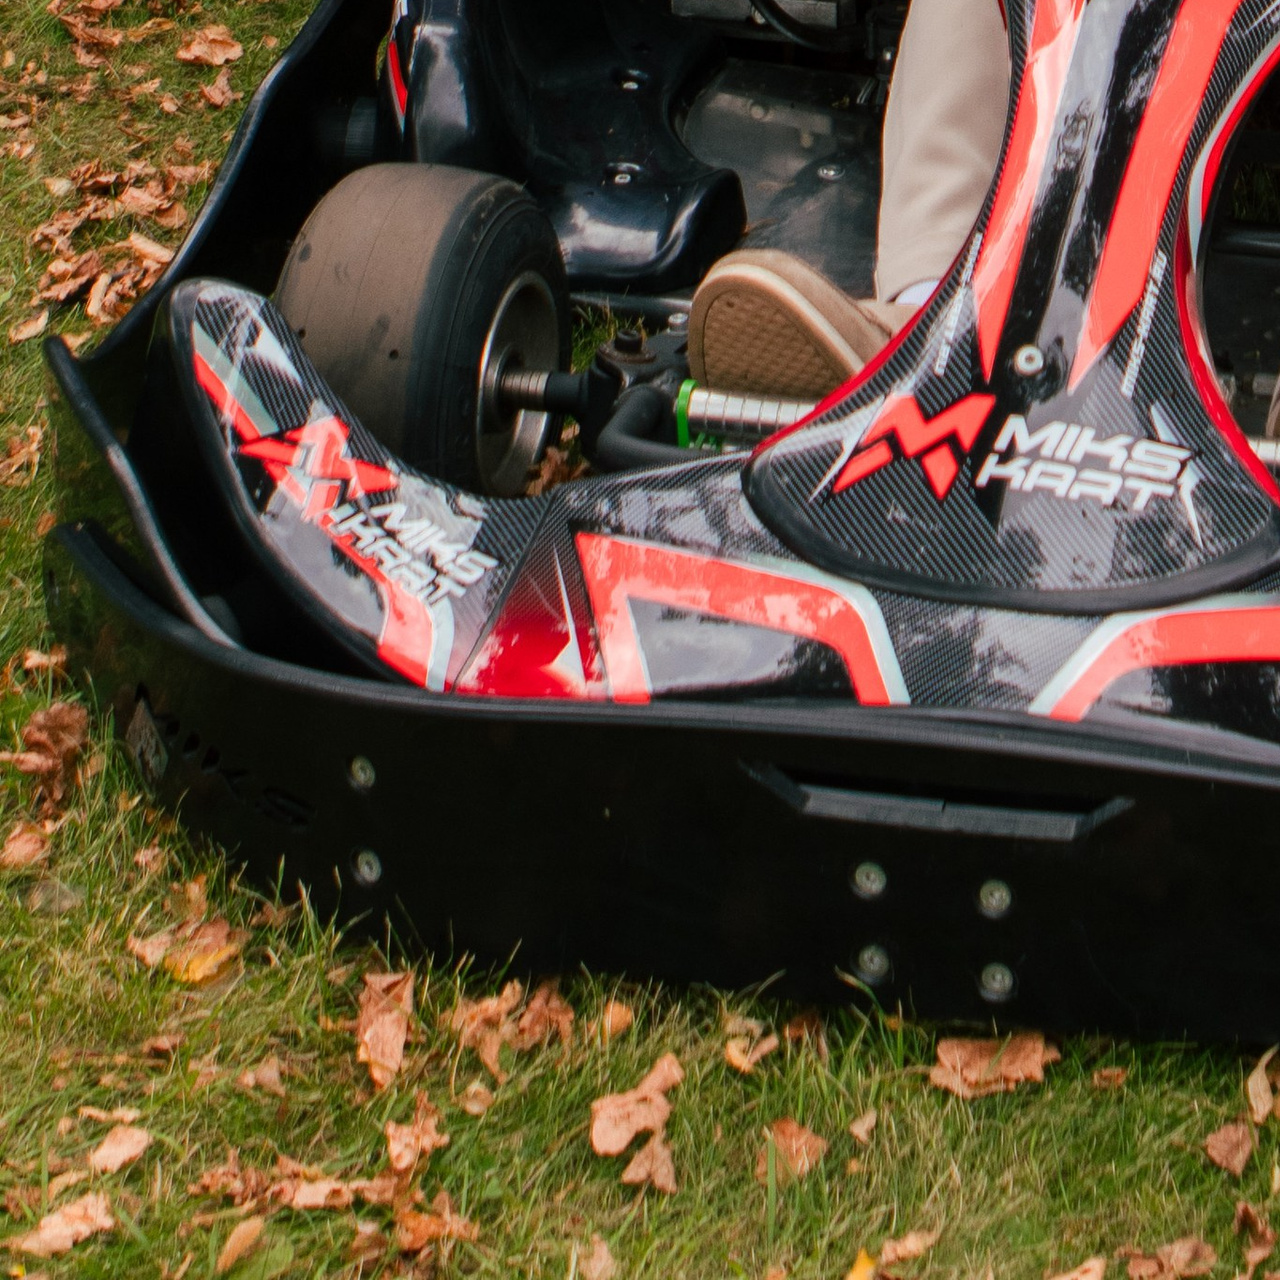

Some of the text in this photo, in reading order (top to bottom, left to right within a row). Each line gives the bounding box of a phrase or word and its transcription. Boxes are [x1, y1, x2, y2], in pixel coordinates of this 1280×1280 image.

[974, 452, 1175, 511] KART
[993, 413, 1192, 481] MIKS
[339, 506, 467, 607] KART
[369, 502, 500, 586] MIKS
